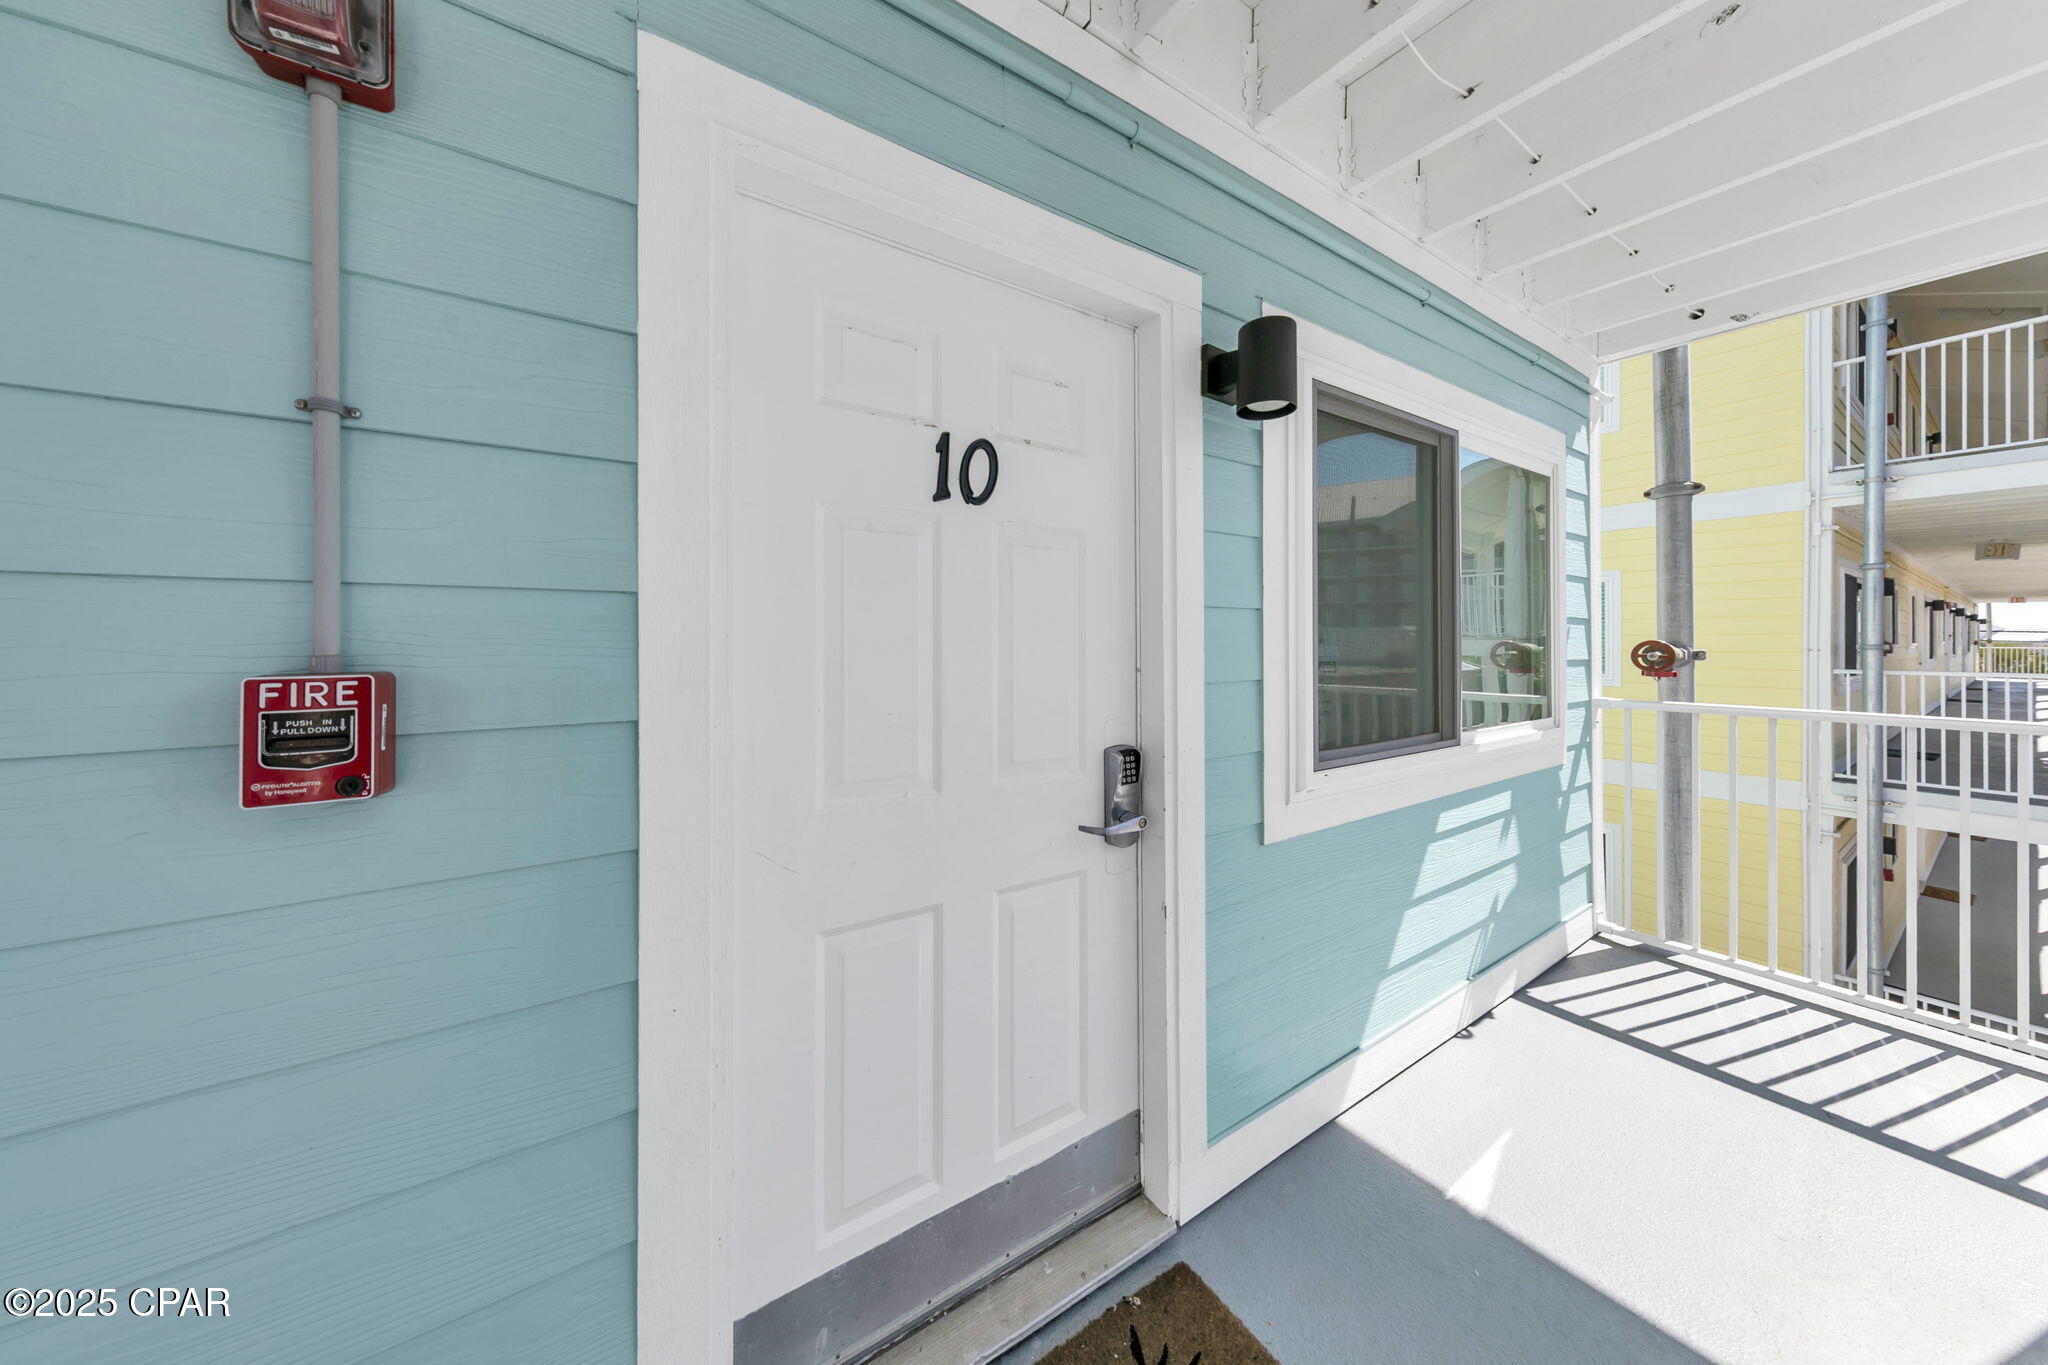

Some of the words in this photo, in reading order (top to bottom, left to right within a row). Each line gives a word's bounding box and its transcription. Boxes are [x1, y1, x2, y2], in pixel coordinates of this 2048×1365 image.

[932, 431, 999, 506] 10
[1984, 544, 2015, 557] EXIT
[259, 680, 358, 709] FIRE
[286, 720, 313, 728] PUSH
[307, 726, 339, 734] DOWN
[274, 788, 307, 796] Honeywell
